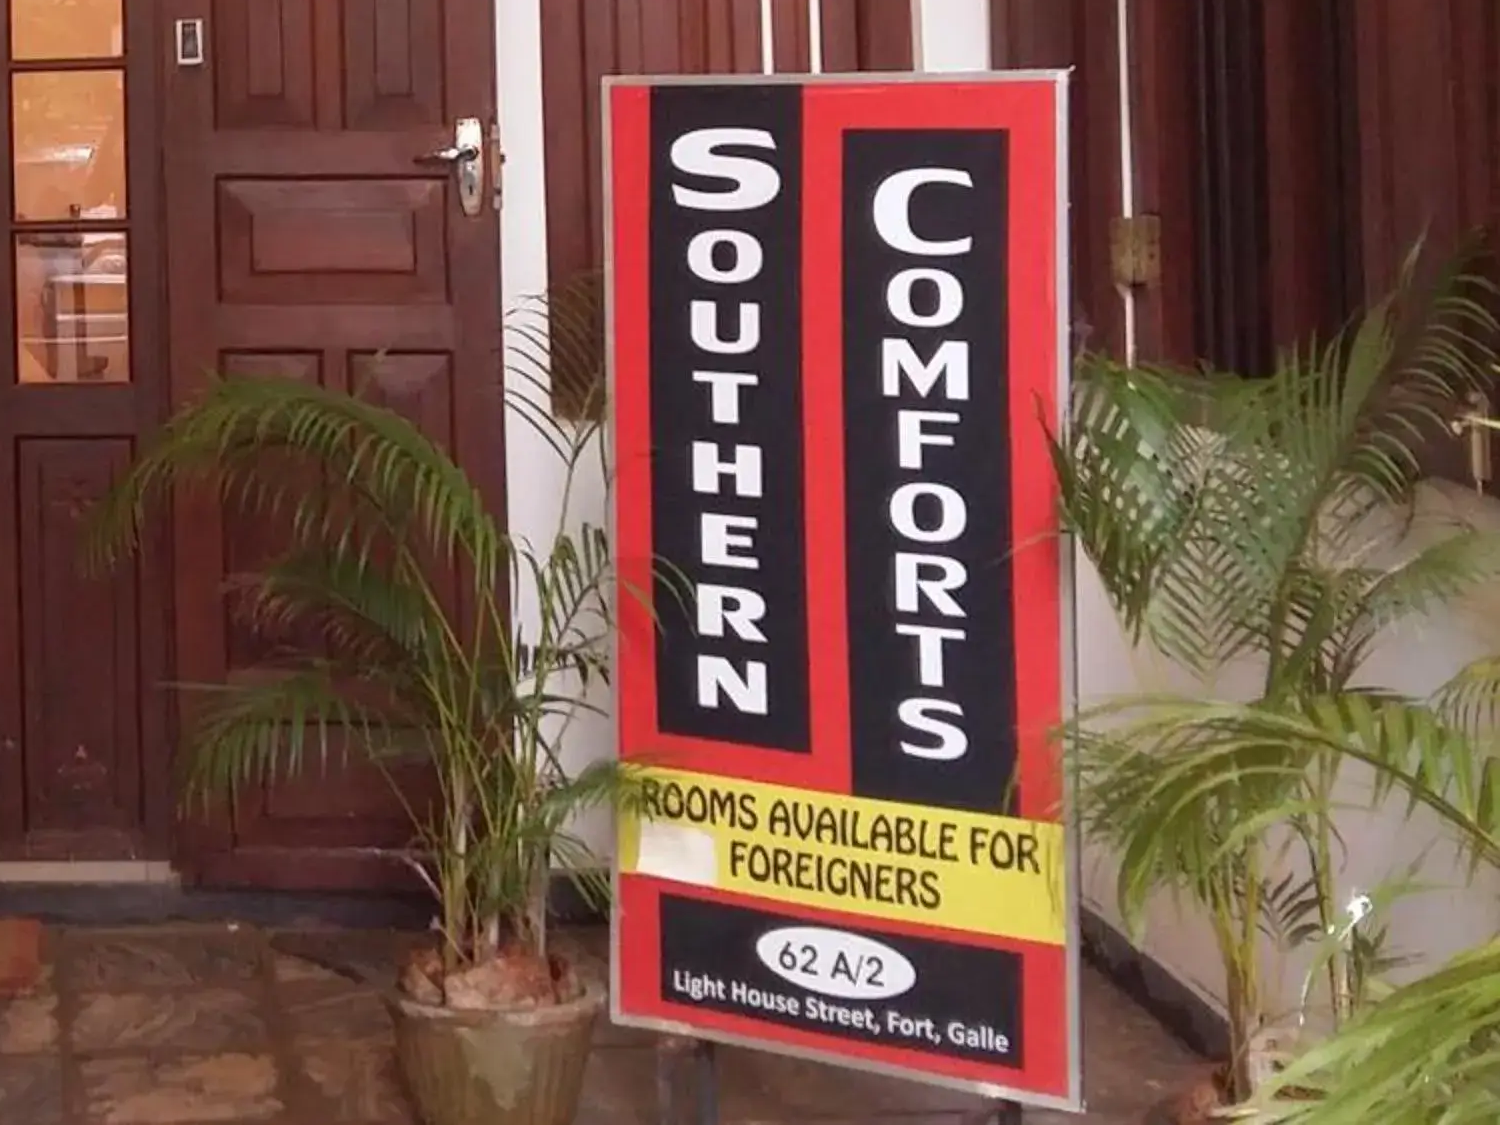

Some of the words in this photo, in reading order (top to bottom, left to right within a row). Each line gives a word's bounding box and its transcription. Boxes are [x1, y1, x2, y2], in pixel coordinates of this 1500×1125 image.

[670, 128, 780, 715] SOUTHERN
[873, 168, 973, 761] COMFORTS
[641, 778, 759, 832] ROOMS
[769, 799, 959, 862] AVAILABLE
[970, 827, 1041, 875] FOR
[730, 839, 941, 910] FOREIGNERS
[778, 941, 819, 976] 62
[830, 950, 885, 988] A/2
[673, 970, 726, 1001] Light
[731, 980, 800, 1016] House
[804, 996, 881, 1036] Street,
[886, 1010, 942, 1046] Fort,
[947, 1021, 1010, 1053] Galle
